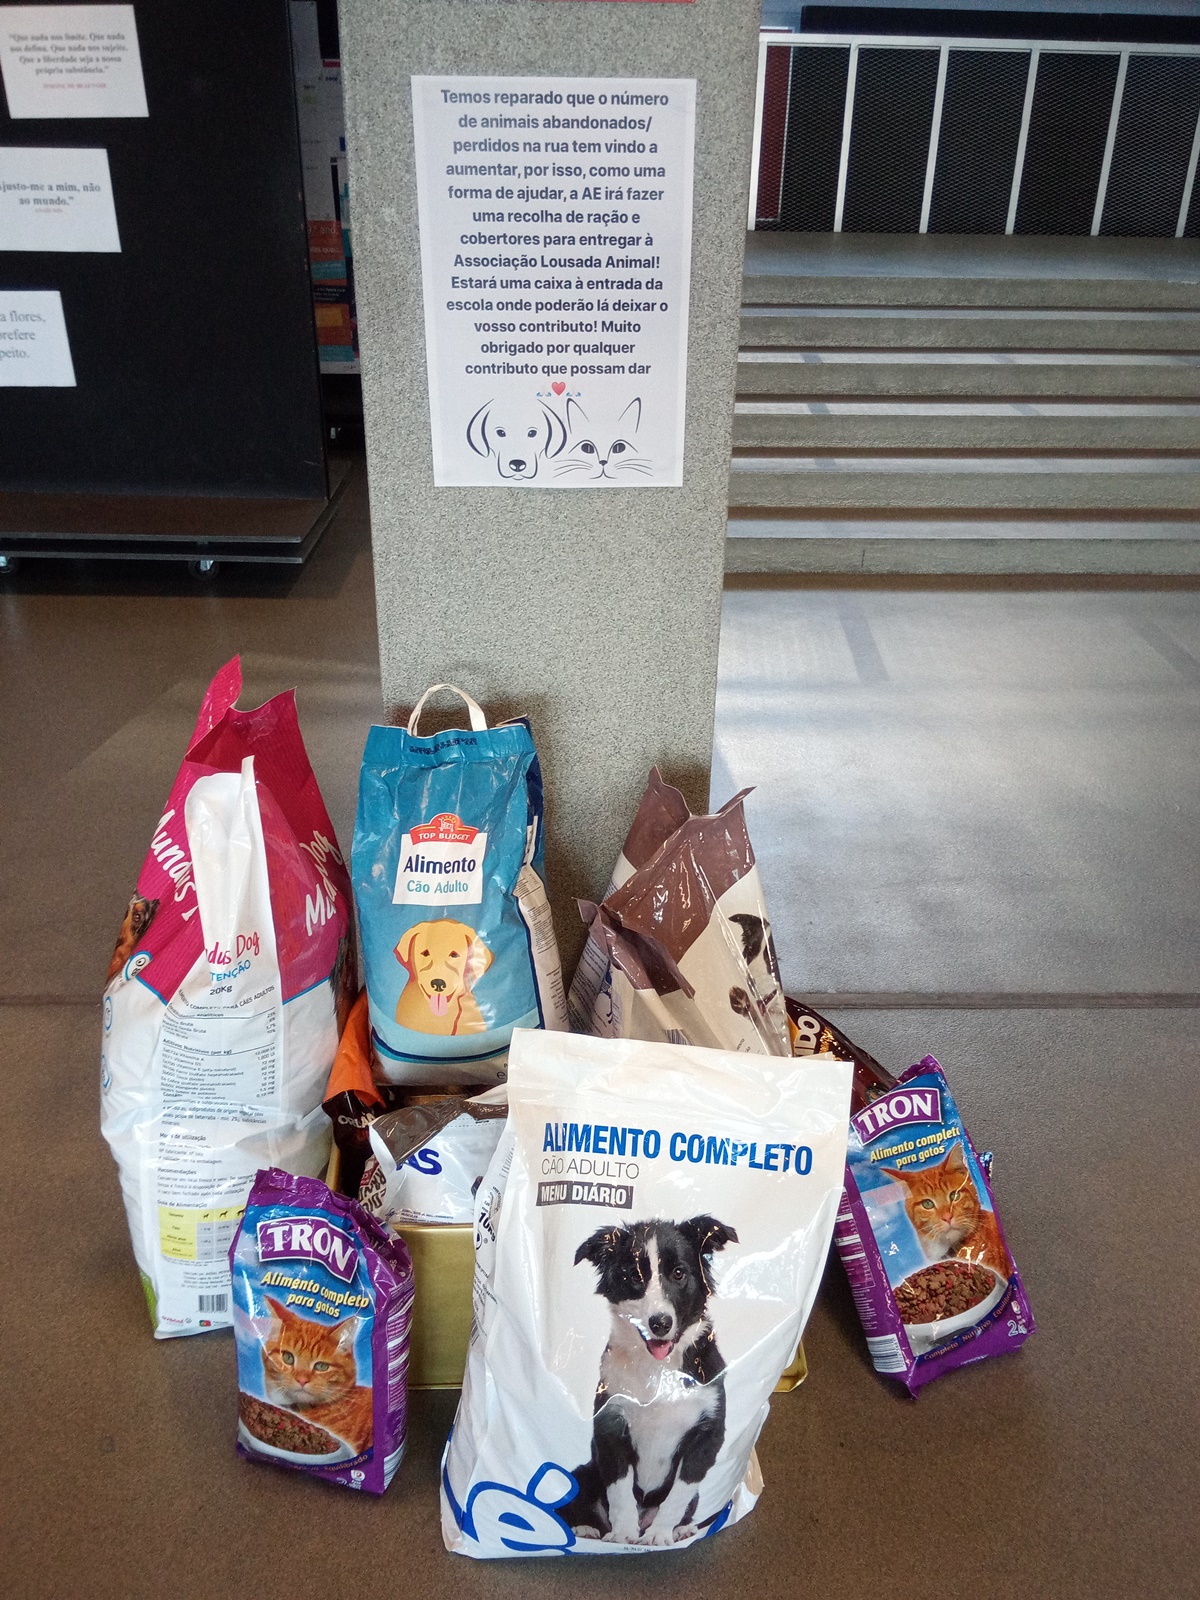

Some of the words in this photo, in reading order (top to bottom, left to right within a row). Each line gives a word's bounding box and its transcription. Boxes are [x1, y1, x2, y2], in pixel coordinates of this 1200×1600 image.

[441, 89, 491, 104] Temos
[494, 91, 563, 107] reparado
[566, 94, 595, 108] que
[598, 94, 607, 105] o
[611, 90, 669, 106] número
[458, 114, 477, 128] de
[481, 114, 539, 129] animais
[542, 115, 652, 132] abandonados/
[453, 138, 519, 154] perdidos
[523, 142, 541, 152] na
[545, 142, 569, 153] rua
[572, 140, 601, 153] tem
[604, 139, 646, 153] vindo
[649, 143, 658, 153] a
[446, 163, 521, 179] aumentar,
[524, 166, 549, 179] por
[552, 162, 586, 179] isso,
[589, 166, 630, 177] como
[634, 167, 665, 177] uma
[48, 184, 53, 192] a
[82, 182, 101, 192] não
[448, 185, 492, 199] forma
[495, 186, 514, 199] de
[517, 186, 567, 203] ajudar,
[569, 190, 578, 200] a
[582, 187, 601, 200] AE
[605, 186, 623, 200] irá
[626, 187, 664, 201] fazer
[473, 212, 504, 222] uma
[508, 210, 562, 223] recolha
[566, 210, 584, 223] de
[587, 210, 628, 227] ração
[632, 213, 640, 224] e
[460, 232, 540, 245] cobertores
[543, 235, 576, 248] para
[579, 234, 642, 249] entregar
[645, 233, 653, 246] à
[454, 254, 537, 271] Associação
[541, 255, 602, 268] Lousada
[605, 255, 660, 269] Animal!
[451, 276, 497, 289] Estará
[500, 279, 531, 289] uma
[534, 276, 572, 289] caixa
[575, 276, 583, 290] à
[586, 278, 642, 290] entrada
[645, 278, 663, 290] da
[446, 299, 493, 311] escola
[496, 299, 532, 311] onde
[535, 298, 594, 314] poderão
[597, 298, 609, 311] lá
[612, 299, 657, 312] deixar
[659, 302, 668, 312] o
[10, 310, 46, 322] flores,
[474, 323, 516, 332] vosso
[519, 320, 597, 332] contributo!
[601, 320, 641, 333] Muito
[481, 341, 543, 356] obrigado
[547, 344, 570, 356] por
[573, 341, 636, 356] qualquer
[465, 362, 538, 374] contributo
[541, 365, 567, 377] que
[571, 365, 625, 377] possam
[628, 362, 651, 374] dar
[418, 832, 437, 840] TOP
[438, 832, 470, 841] BUDGET
[403, 854, 476, 874] Alimento
[407, 879, 430, 894] Cão
[434, 880, 469, 894] Adulto
[236, 932, 260, 959] Dog
[210, 985, 233, 996] 20Kg
[253, 986, 275, 1000] ADULTOS
[857, 1091, 934, 1136] TRON
[542, 1122, 661, 1159] ALIMENTO
[670, 1131, 814, 1176] COMPLETO
[870, 1138, 915, 1163] Alimento
[896, 1152, 918, 1170] para
[918, 1144, 946, 1164] gatos
[541, 1153, 564, 1177] CÃO
[566, 1158, 640, 1181] ADULTO
[541, 1184, 568, 1204] MENU
[571, 1182, 628, 1206] DIÁRIO
[266, 1223, 354, 1272] TRON
[261, 1271, 320, 1295] Alimento
[320, 1287, 370, 1308] completo
[286, 1294, 315, 1309] para
[315, 1300, 340, 1318] gatos
[924, 1342, 959, 1361] Completo
[962, 1320, 992, 1342] Nutritivo
[324, 1453, 369, 1472] Equilibrado
